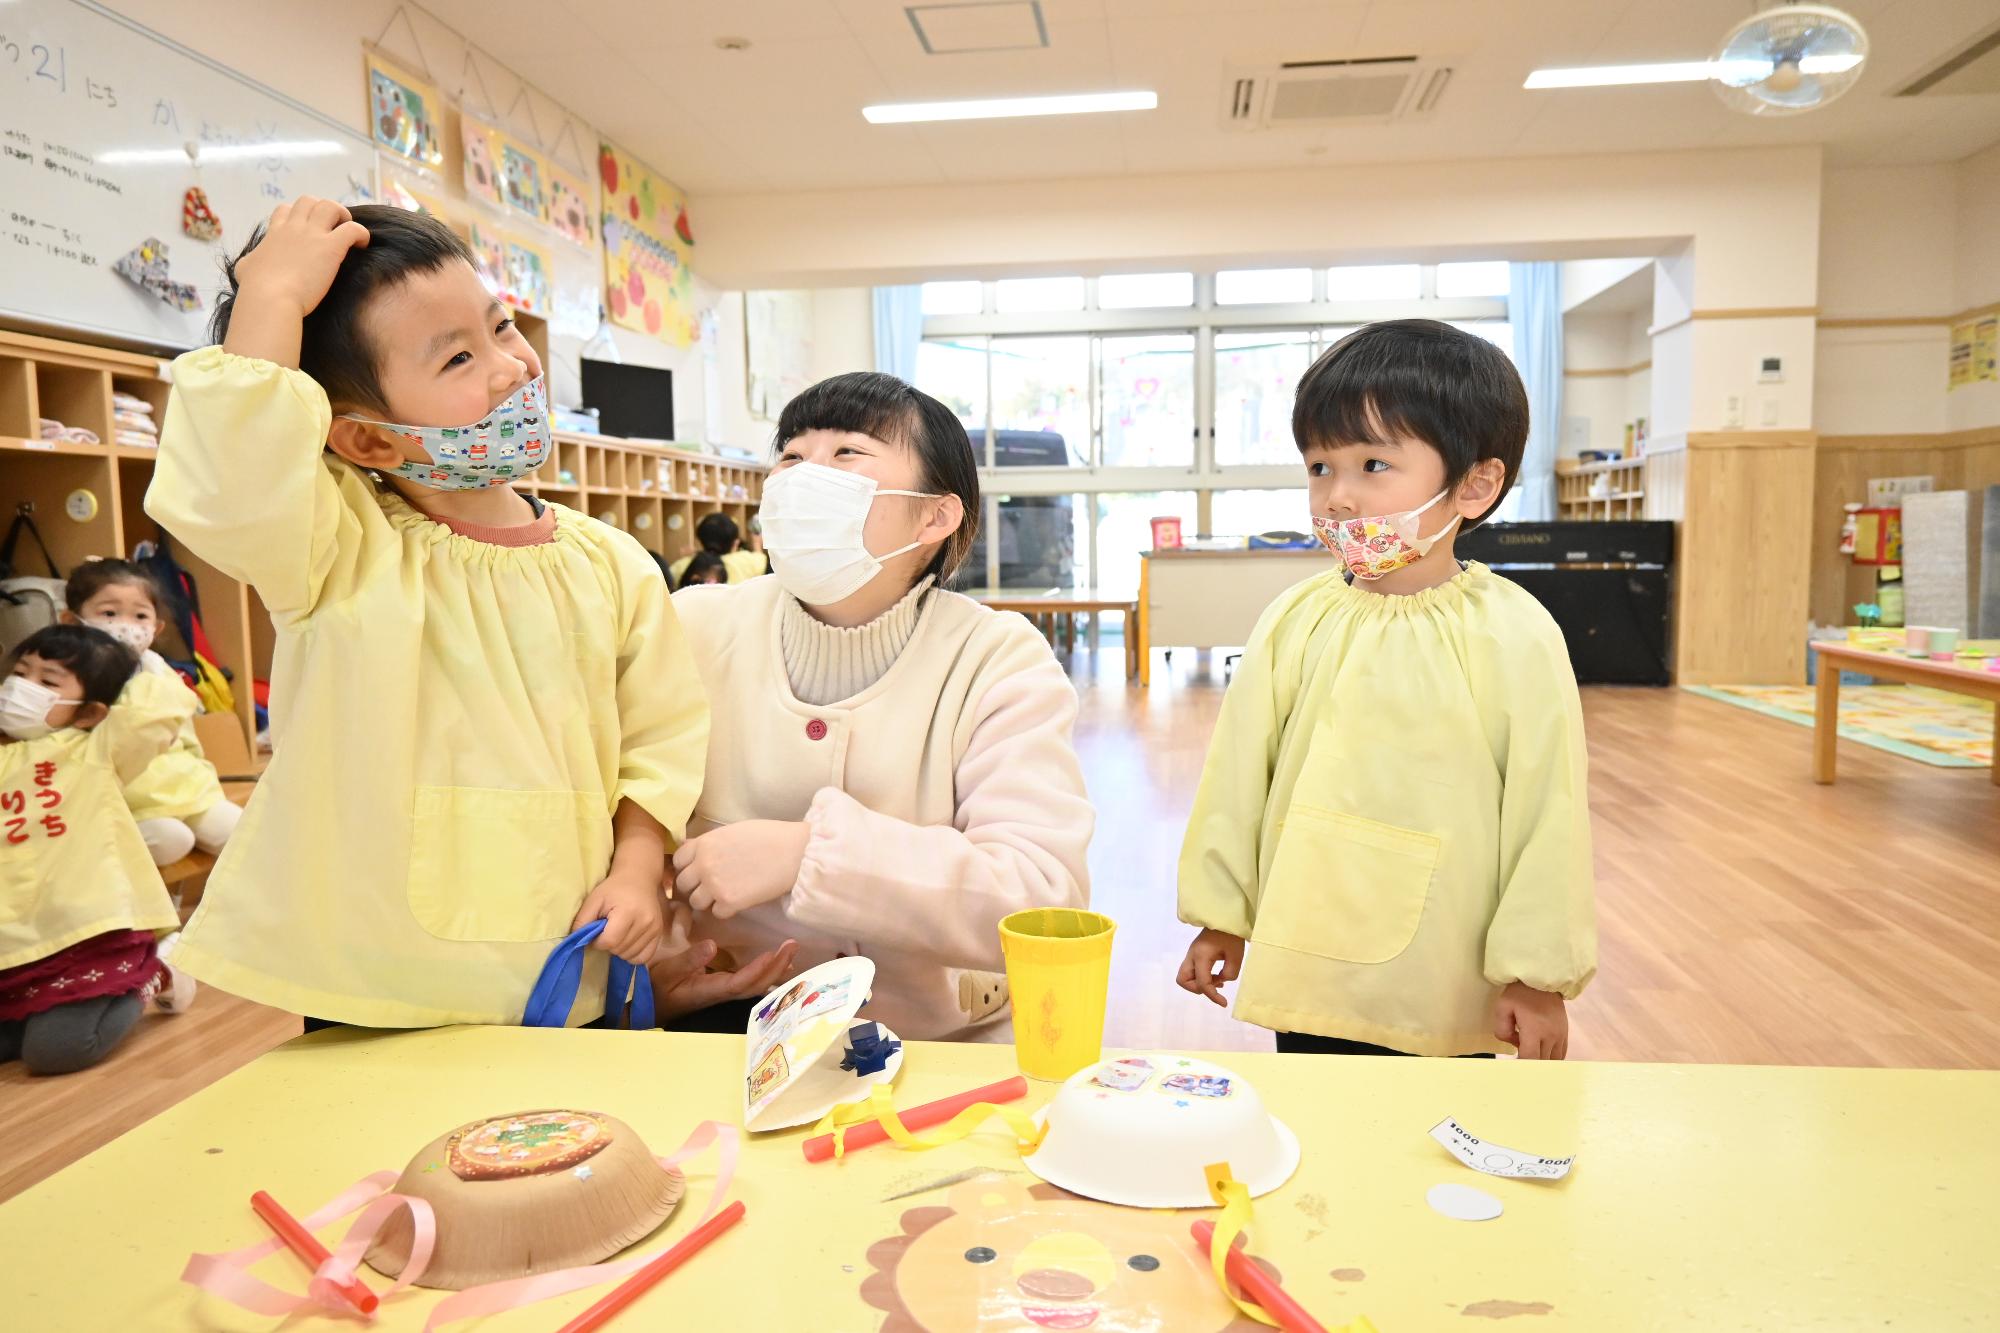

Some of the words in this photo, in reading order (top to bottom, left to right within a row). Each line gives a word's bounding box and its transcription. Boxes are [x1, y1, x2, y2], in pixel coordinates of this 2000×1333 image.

[31, 44, 66, 92] 21
[1450, 1122, 1479, 1145] 1000
[1537, 1158, 1571, 1166] 1000
